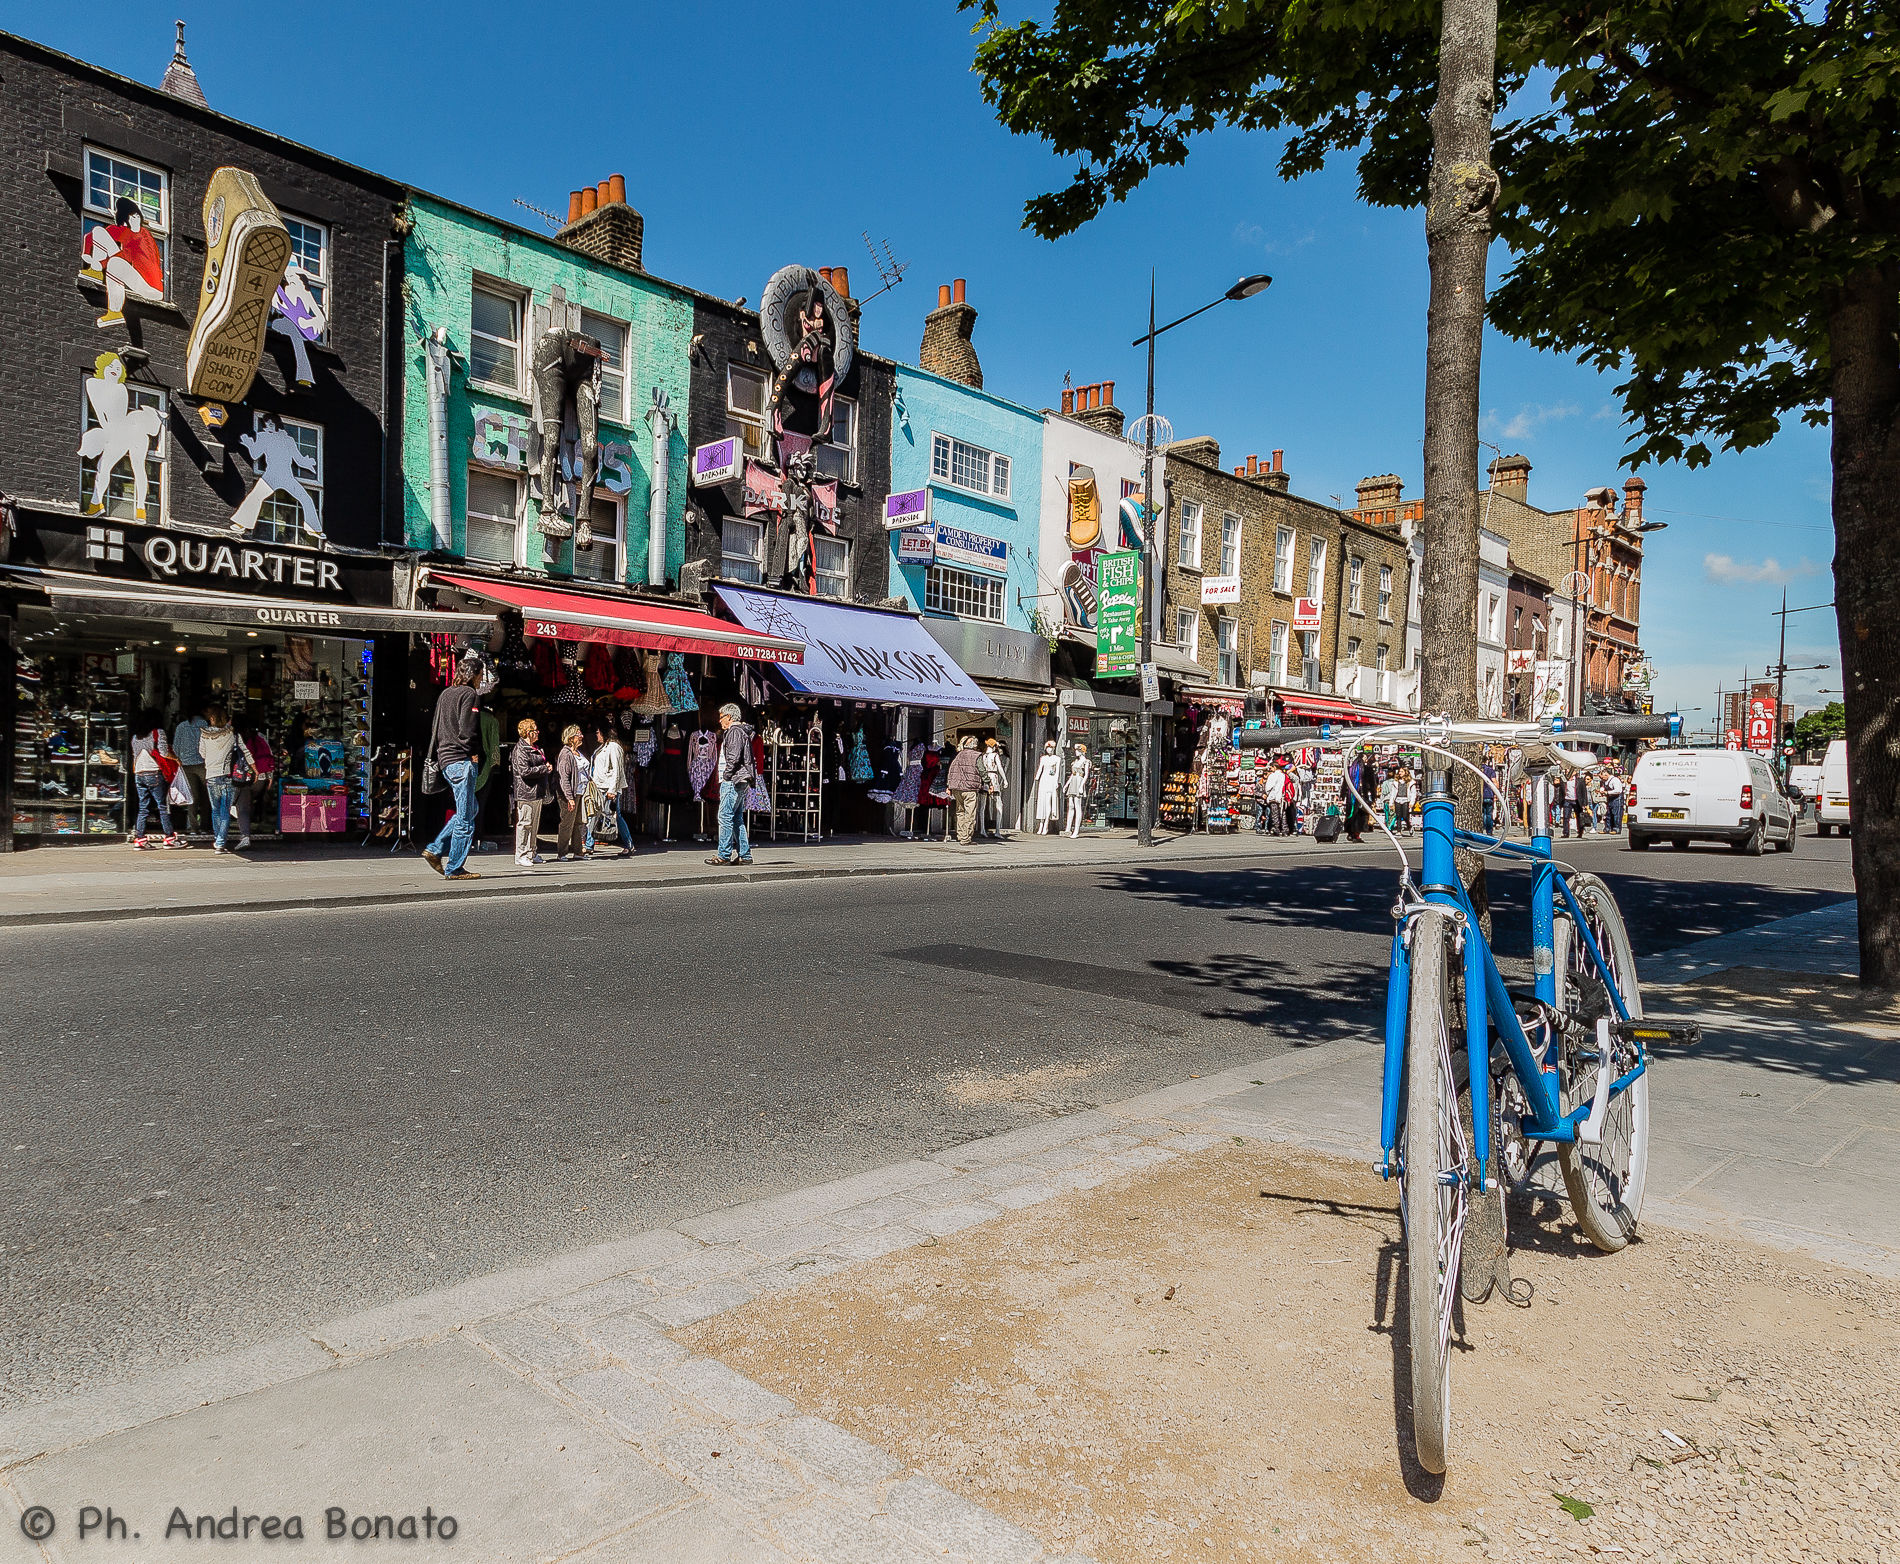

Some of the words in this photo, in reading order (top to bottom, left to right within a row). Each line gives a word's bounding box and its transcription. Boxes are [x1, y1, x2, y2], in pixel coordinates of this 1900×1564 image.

[247, 275, 263, 292] 4
[767, 269, 802, 317] NEW
[206, 342, 257, 366] QUARTER
[207, 361, 245, 380] SHOES
[701, 466, 729, 481] DARKSIDE
[742, 485, 842, 526] DARKIDE
[891, 513, 920, 525] DARKSIDE
[902, 538, 917, 548] LET
[919, 539, 931, 549] BY
[938, 525, 968, 541] CAMDEN
[968, 532, 1001, 550] PROPERTY
[945, 536, 993, 556] CONSULTANCY
[145, 536, 343, 592] QUARTER
[1102, 556, 1135, 568] BRITISH
[1103, 565, 1134, 581] FISH
[1102, 580, 1110, 588] &
[1110, 577, 1135, 588] CHIPS
[1205, 587, 1218, 595] FOR
[1219, 586, 1236, 594] SALE
[256, 608, 342, 625] QUARTER
[1102, 609, 1132, 619] Restaurant
[536, 622, 558, 636] 243
[737, 645, 755, 658] 020
[755, 648, 776, 660] 7284
[777, 650, 798, 663] 1742
[1113, 644, 1125, 652] Min
[1068, 718, 1089, 732] SALE
